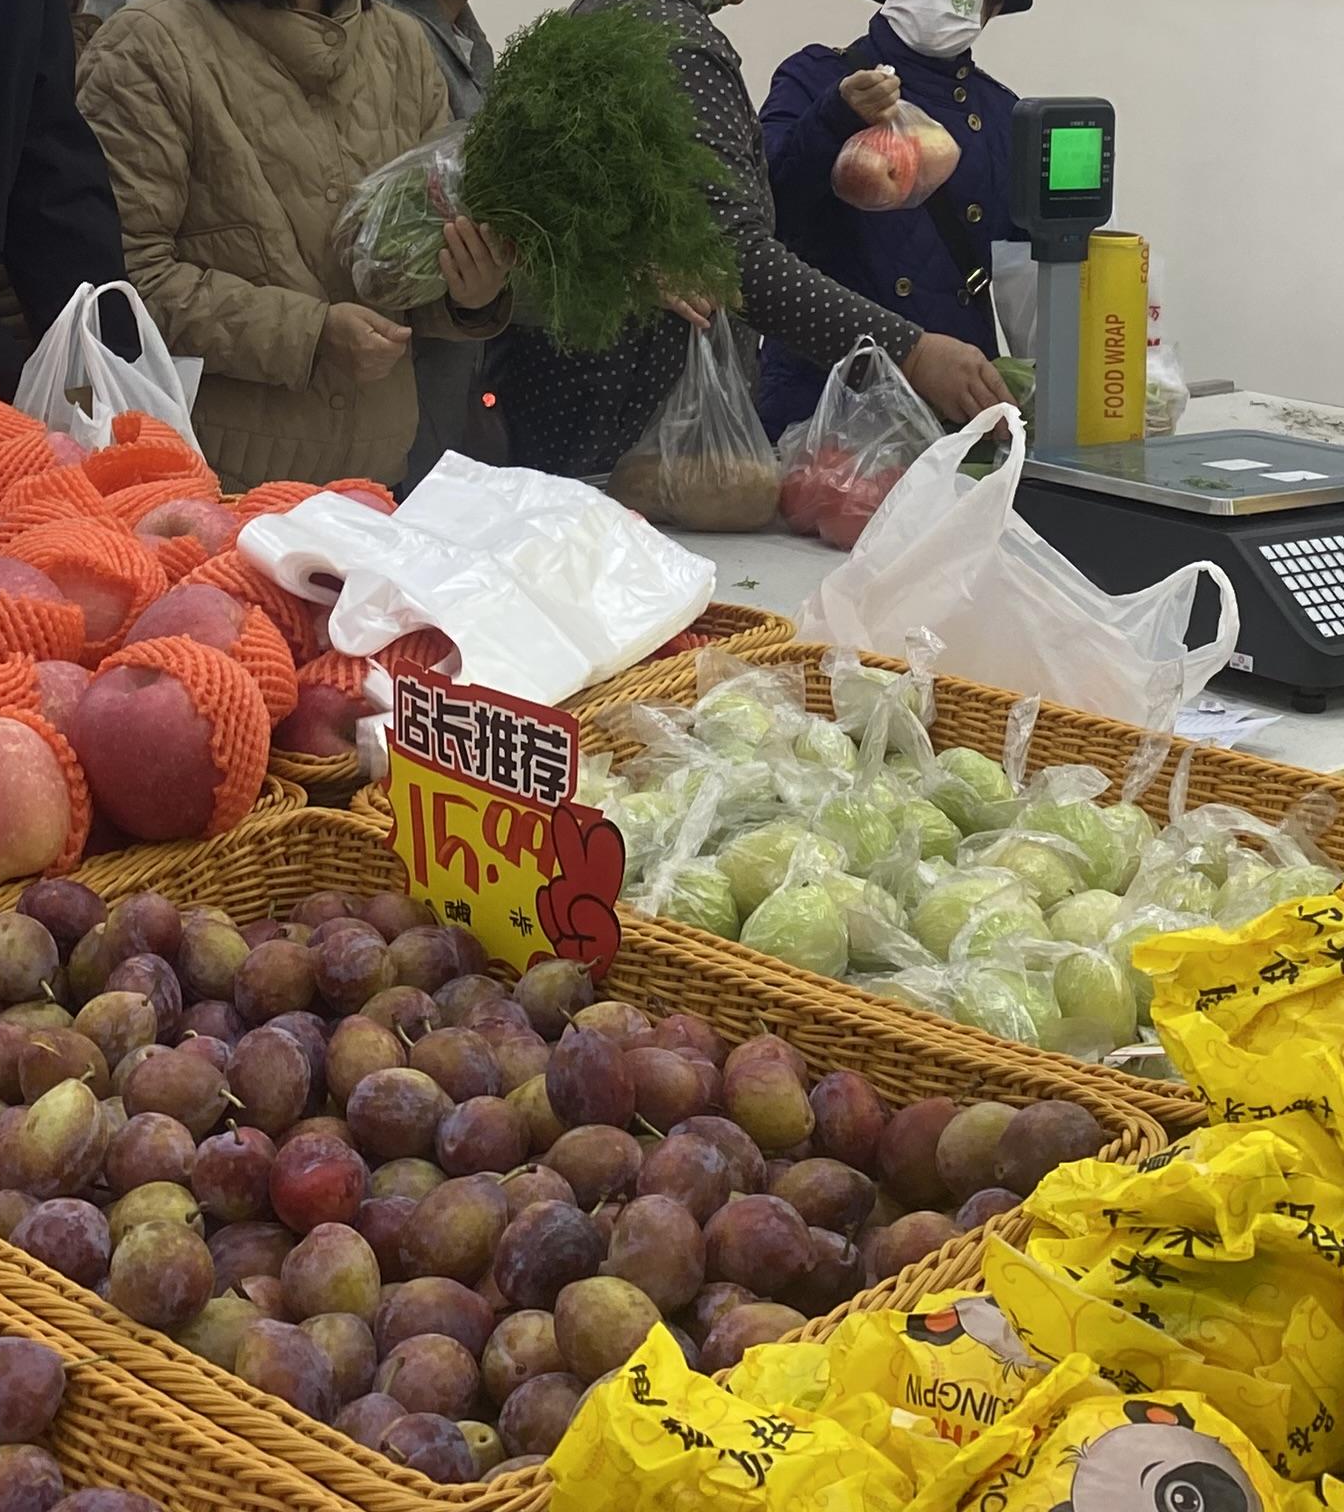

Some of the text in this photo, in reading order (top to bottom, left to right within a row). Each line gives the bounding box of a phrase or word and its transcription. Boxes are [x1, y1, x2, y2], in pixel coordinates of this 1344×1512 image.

[1104, 314, 1126, 418] FOOD WRAP
[398, 677, 569, 805] 店长推荐
[409, 783, 559, 895] 15.99
